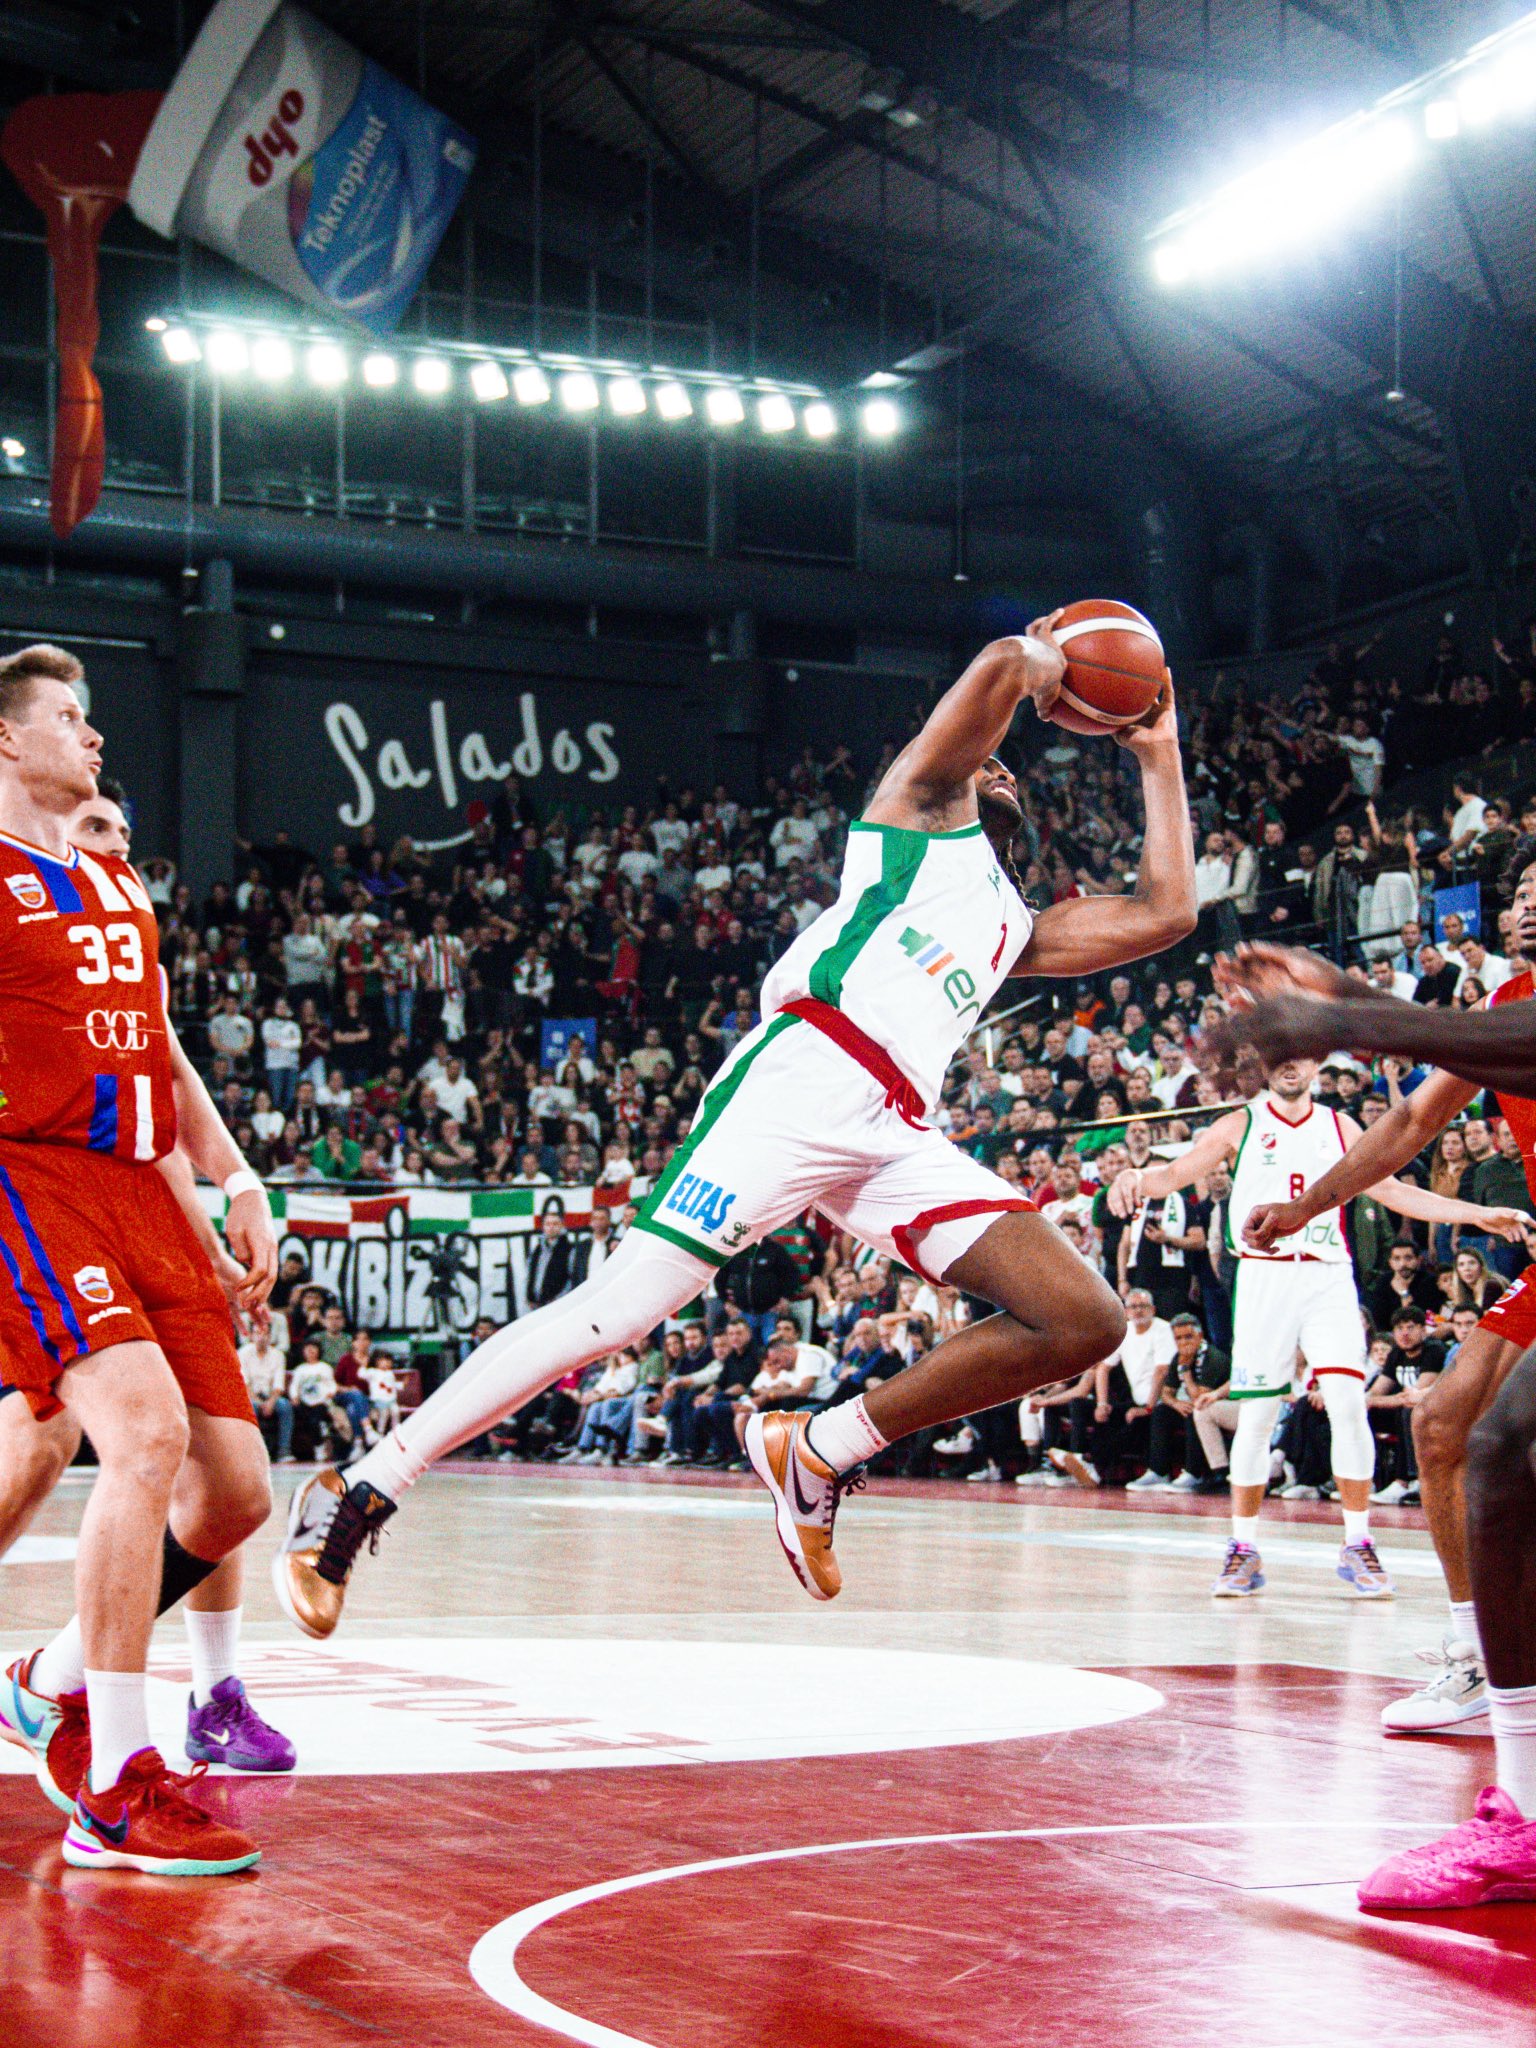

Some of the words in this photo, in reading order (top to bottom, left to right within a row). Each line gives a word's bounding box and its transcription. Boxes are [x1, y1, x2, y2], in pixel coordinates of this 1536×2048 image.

[244, 88, 304, 187] dyo
[302, 115, 388, 253] Teknoplast
[325, 692, 620, 828] Salados
[67, 922, 144, 985] 33
